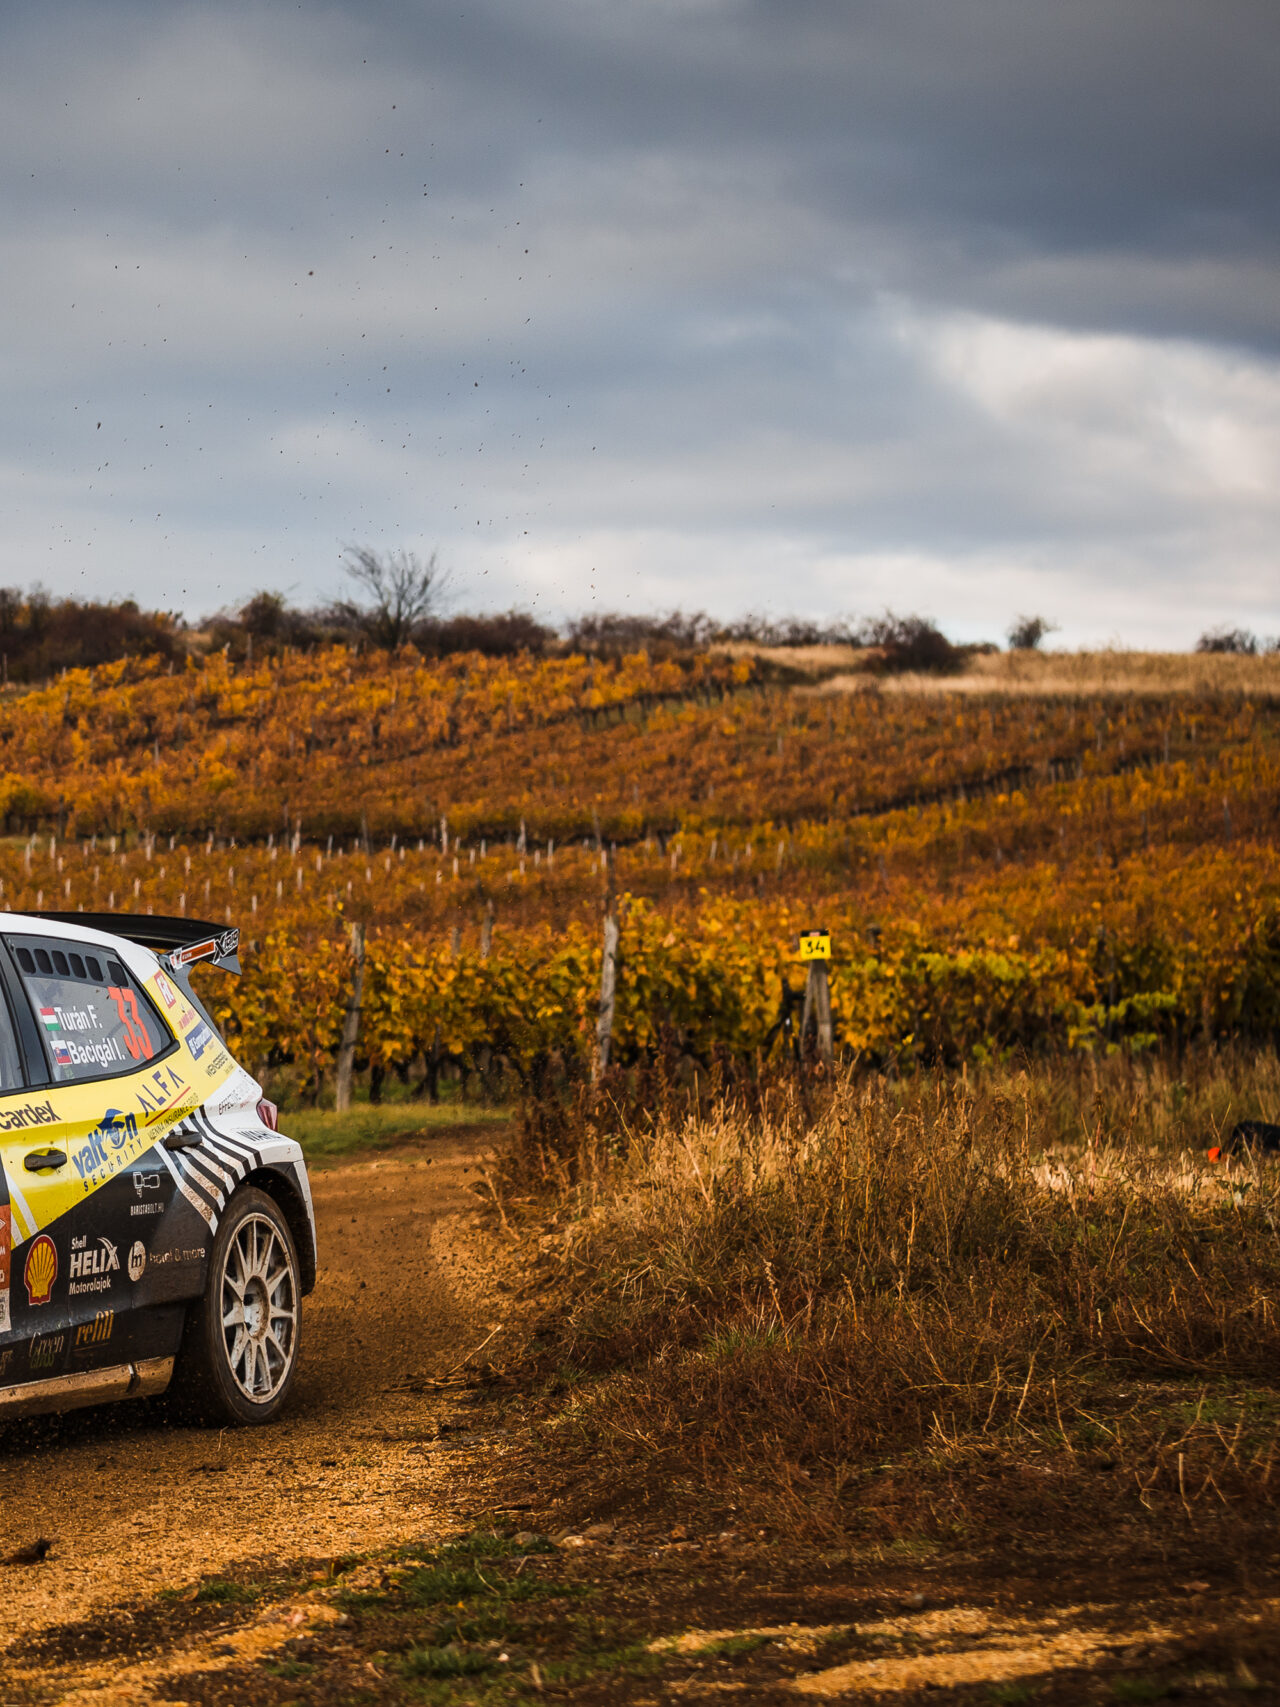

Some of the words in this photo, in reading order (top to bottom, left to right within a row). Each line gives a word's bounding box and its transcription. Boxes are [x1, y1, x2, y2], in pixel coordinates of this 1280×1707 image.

[53, 1006, 89, 1031] Turán
[87, 1004, 103, 1029] F.
[107, 986, 154, 1060] 33
[66, 1038, 111, 1068] Bacigál
[135, 1065, 185, 1118] ALFA
[83, 1138, 143, 1192] SECURITY
[70, 1238, 120, 1278] HELIX
[71, 1235, 87, 1250] Shell
[69, 1275, 111, 1296] Motorolajok
[75, 1309, 115, 1345] refill
